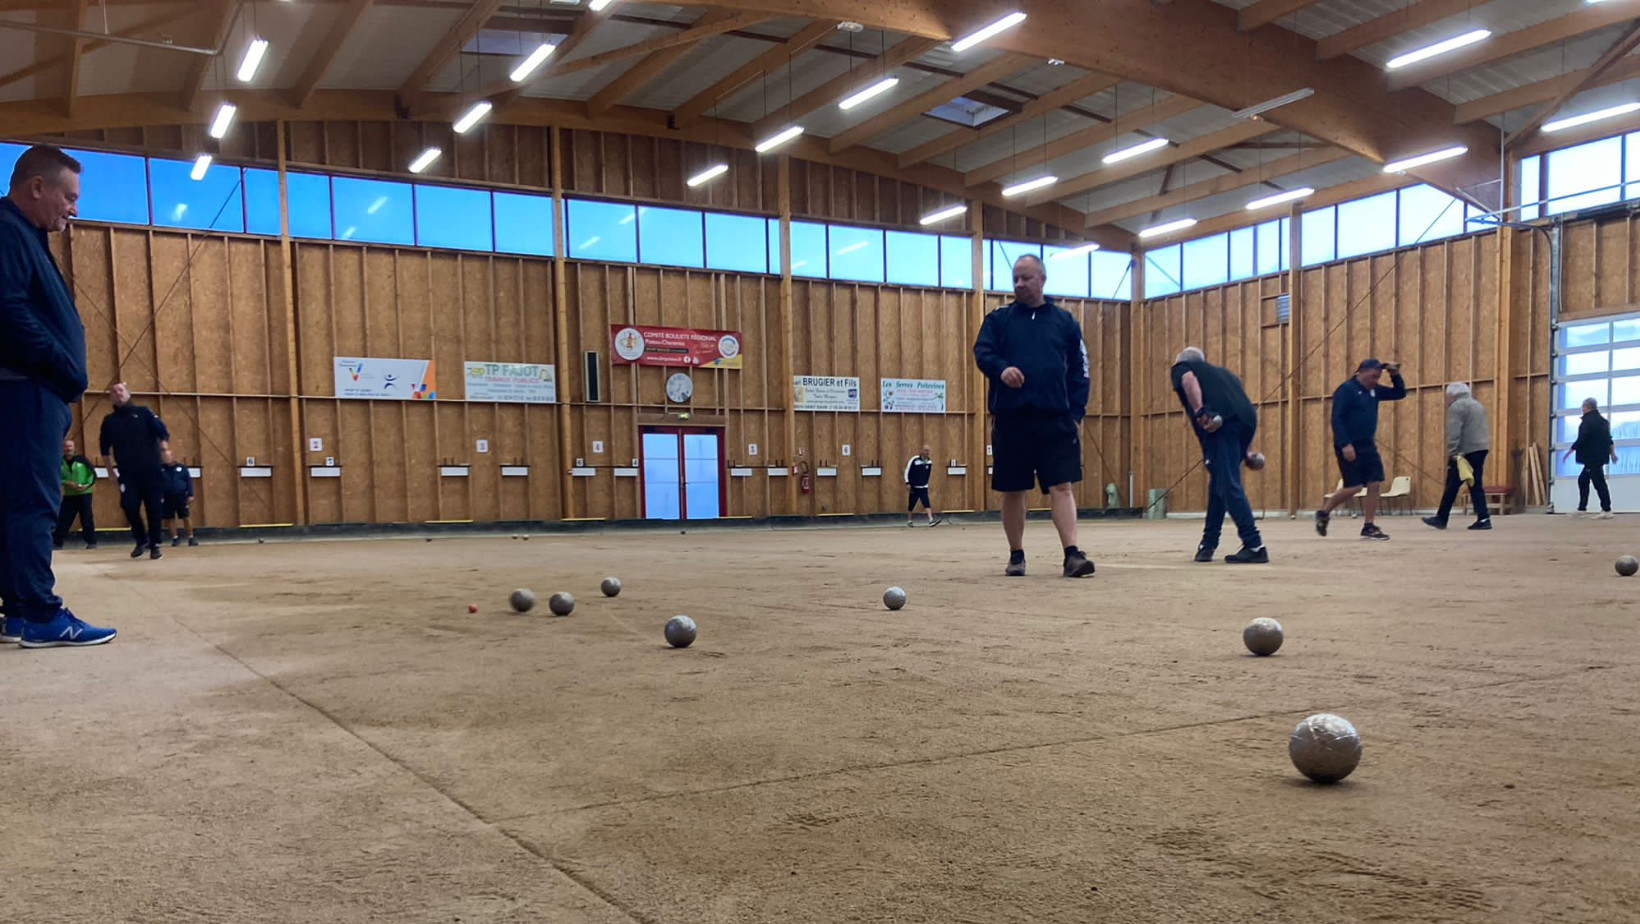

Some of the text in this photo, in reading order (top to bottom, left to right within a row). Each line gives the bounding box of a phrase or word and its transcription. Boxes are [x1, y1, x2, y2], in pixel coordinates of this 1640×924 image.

[485, 364, 539, 377] TP FAJOT
[802, 377, 835, 387] BRUGIER
[836, 379, 843, 387] et
[844, 378, 857, 388] Fils
[882, 380, 945, 390] Les Serres Poitevines
